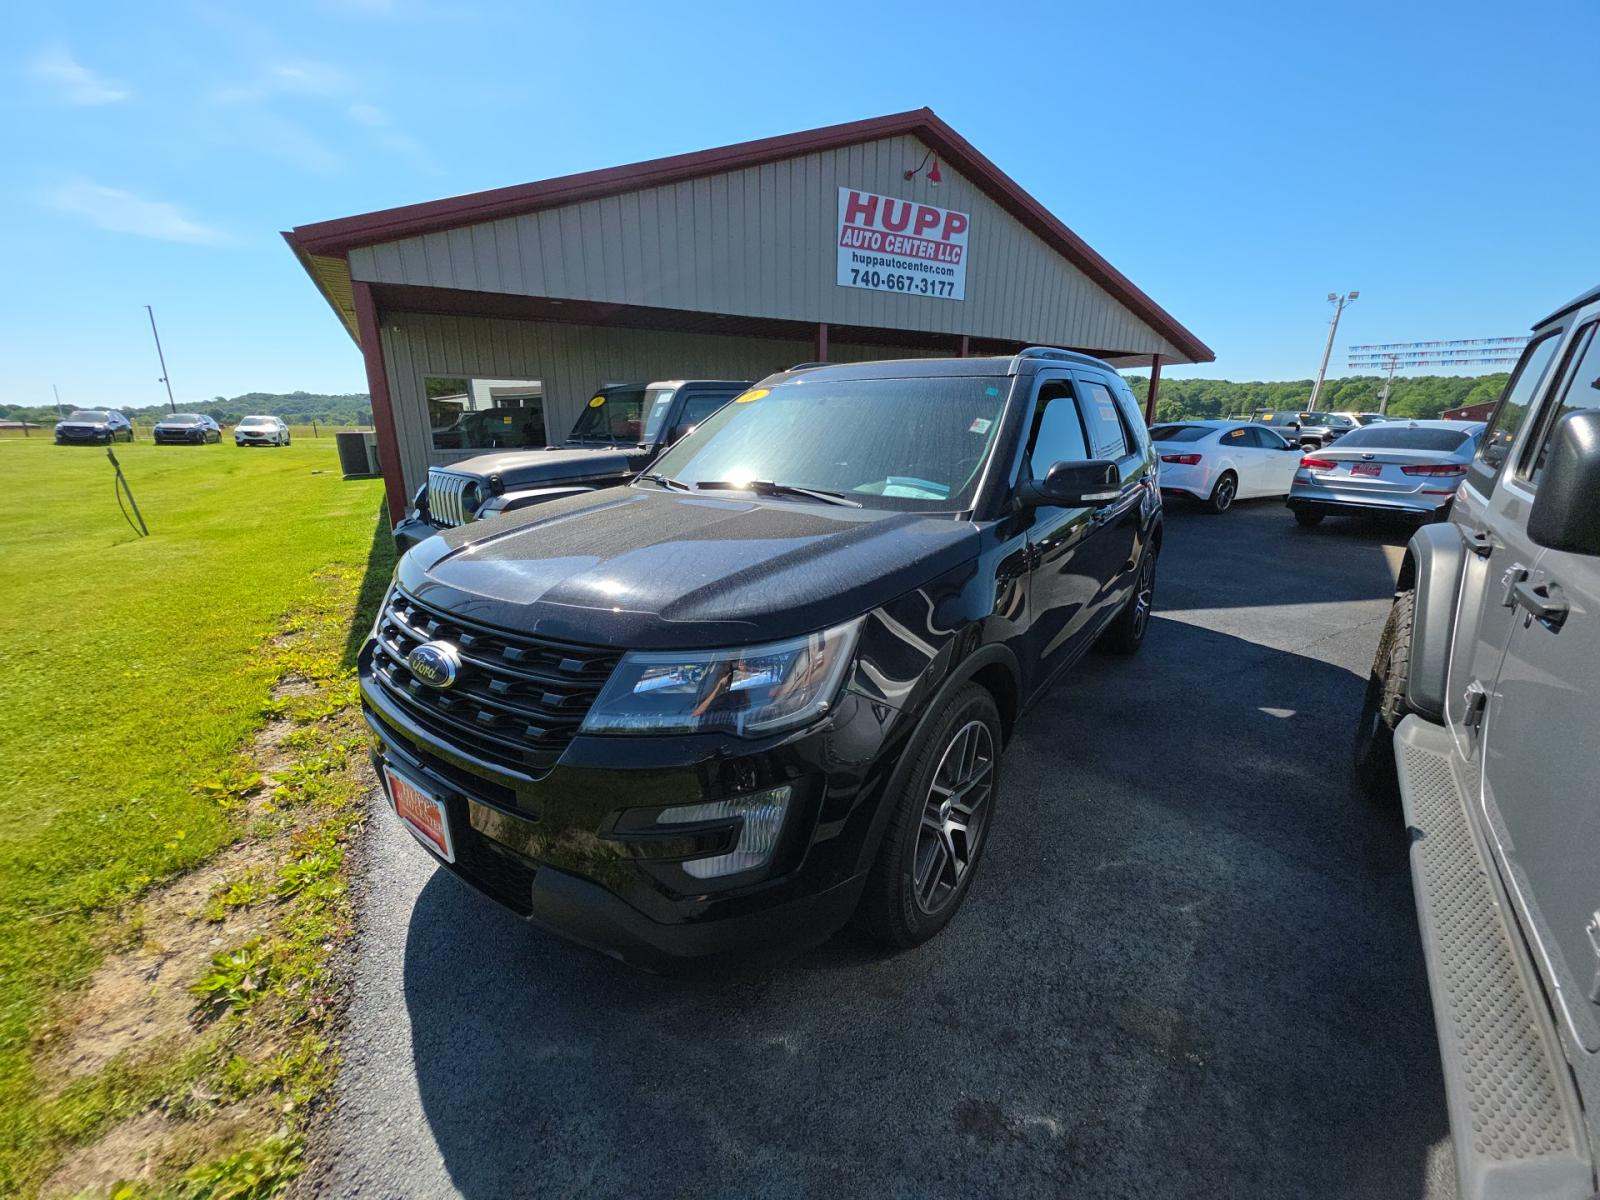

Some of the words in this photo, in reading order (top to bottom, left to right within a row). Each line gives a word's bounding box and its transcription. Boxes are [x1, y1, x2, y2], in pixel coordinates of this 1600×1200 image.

[845, 191, 968, 240] HUPP
[843, 228, 881, 249] AUTO
[885, 236, 936, 258] CENTER
[938, 244, 961, 262] LLC
[852, 252, 954, 276] huppautocenter.com
[412, 654, 439, 679] Ford
